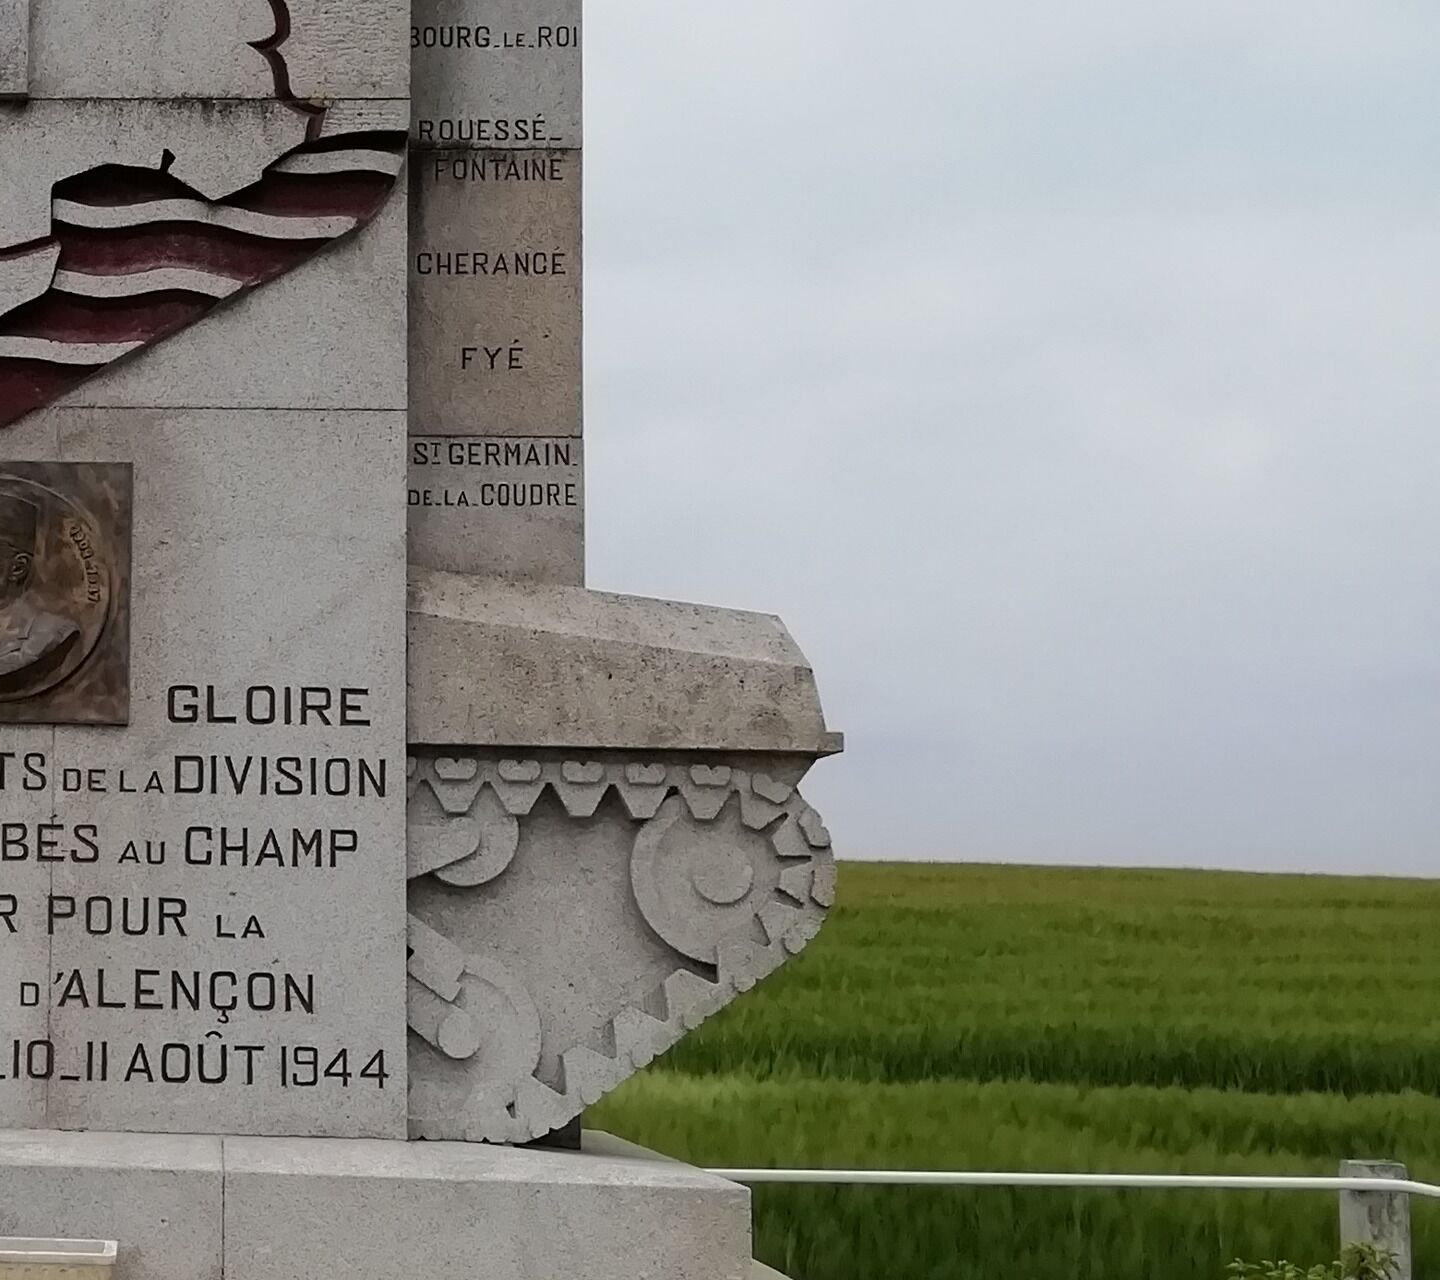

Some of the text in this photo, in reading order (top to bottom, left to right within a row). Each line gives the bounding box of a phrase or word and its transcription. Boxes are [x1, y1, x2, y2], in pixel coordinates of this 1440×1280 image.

[433, 158, 564, 182] FONTAINE
[461, 338, 523, 370] FYÉ
[167, 685, 371, 726] GLOIRE
[62, 767, 107, 792] DE
[119, 771, 165, 794] LA
[174, 755, 387, 798] DIVISION
[118, 840, 166, 864] AU
[184, 826, 359, 868] CHAMP
[48, 894, 188, 937] POUR
[215, 914, 266, 939] LA
[20, 967, 315, 1024] D'ALENÇON
[124, 1030, 266, 1086] AOÛT
[280, 1045, 390, 1090] 1944
